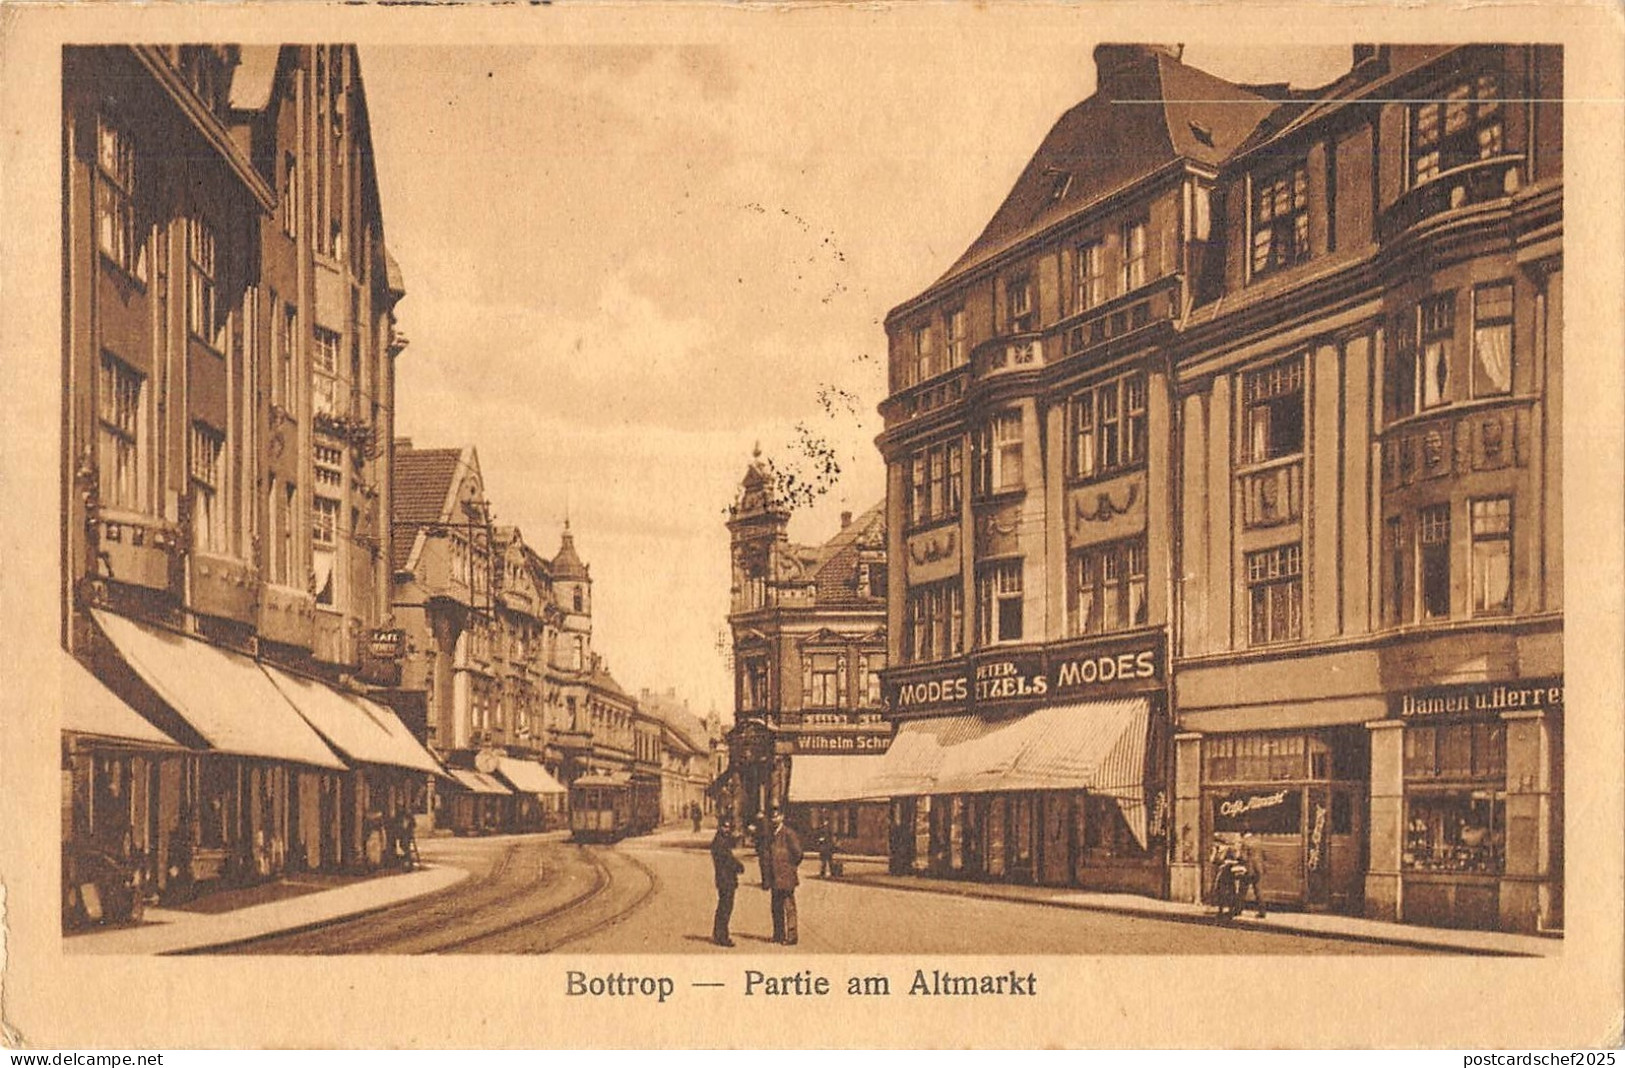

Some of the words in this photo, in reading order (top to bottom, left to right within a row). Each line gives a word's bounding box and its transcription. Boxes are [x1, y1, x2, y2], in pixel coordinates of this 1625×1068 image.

[1057, 651, 1155, 687] MODES
[898, 678, 968, 706] MODES
[1402, 694, 1469, 716] Damen
[797, 736, 854, 749] Wilhelm
[565, 971, 675, 1003] Bottrop
[744, 970, 830, 996] Partie
[847, 975, 891, 996] am
[908, 970, 1037, 996] Altmarkt
